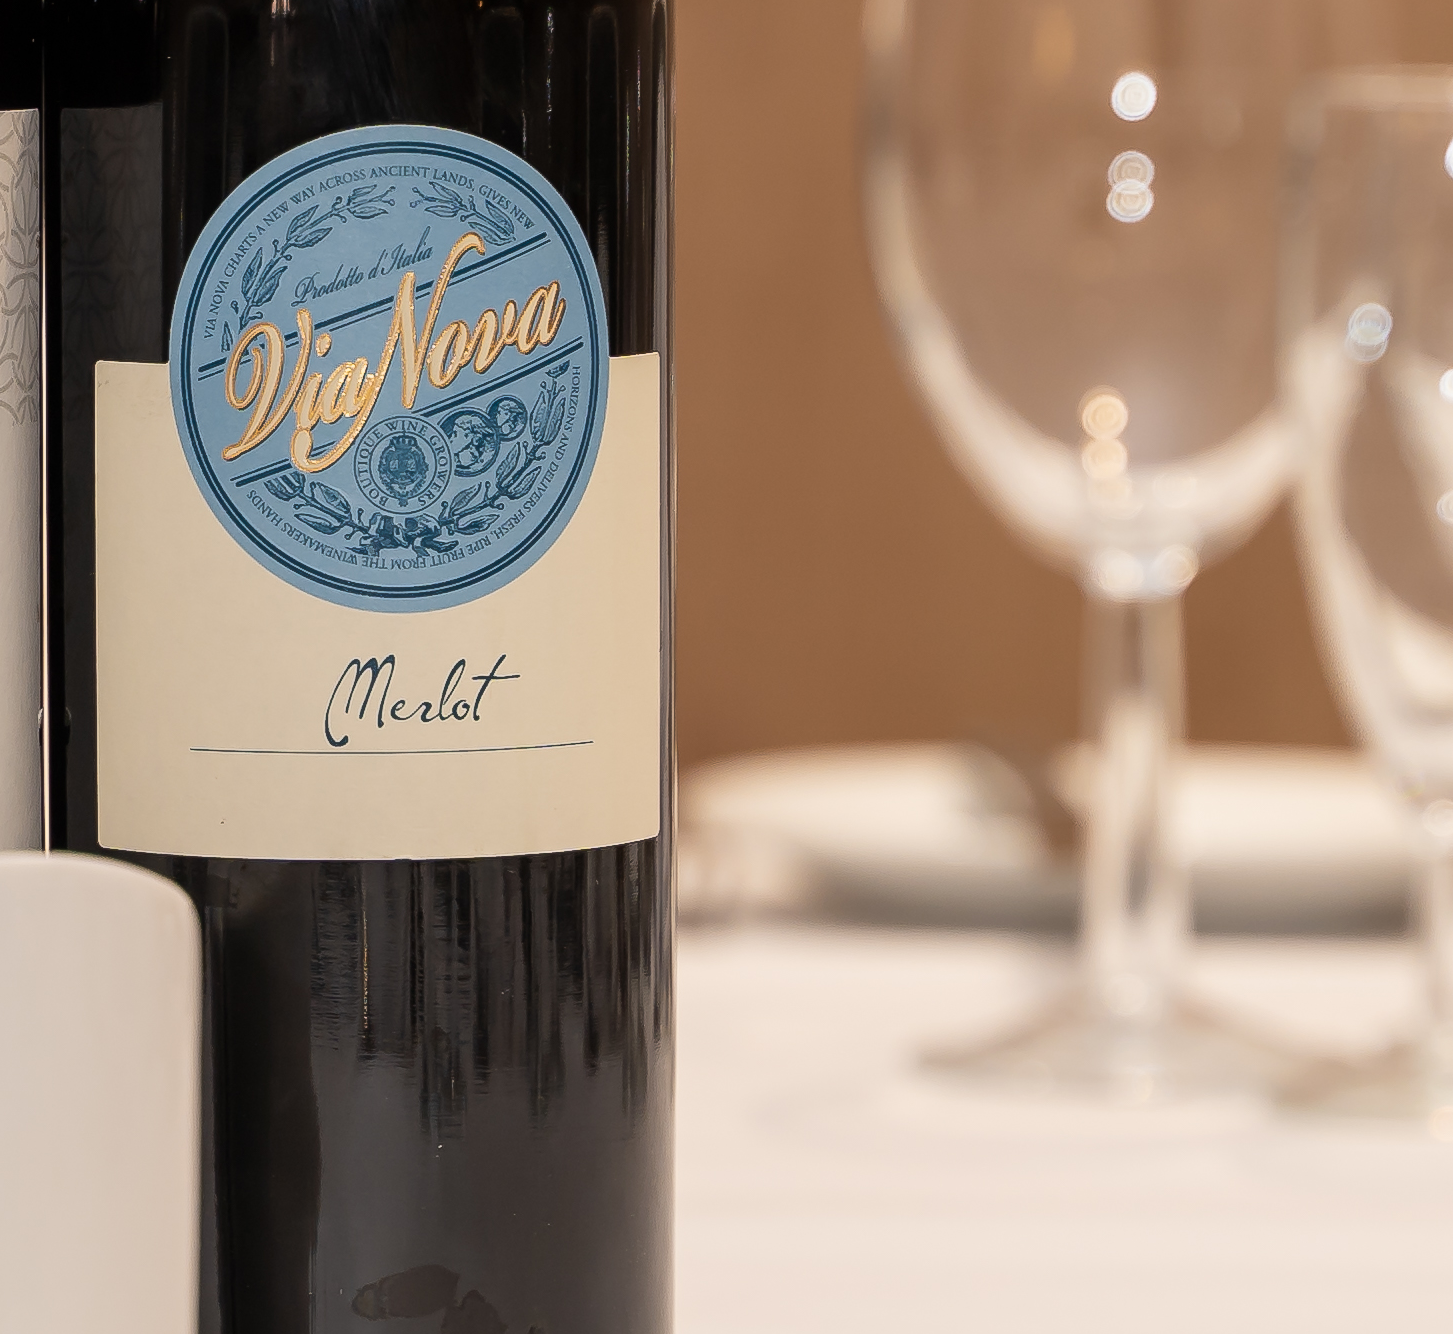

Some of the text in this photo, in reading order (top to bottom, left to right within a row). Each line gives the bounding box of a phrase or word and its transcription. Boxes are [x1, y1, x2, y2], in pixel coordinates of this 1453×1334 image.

[203, 165, 537, 339] VIA NOVA CHARTS A NEW WAY ACROSS ANCIENT LANDS, GIVES NEW
[290, 225, 434, 308] Prodotto d'Italia
[245, 365, 581, 570] HORIZONS AND DELIVERS FRESH, RIPE FRUIT FROM THE WINEMAKERS HANDS
[357, 419, 449, 506] BOUTIQUE WINE GROWERS
[324, 653, 522, 747] Merlot
